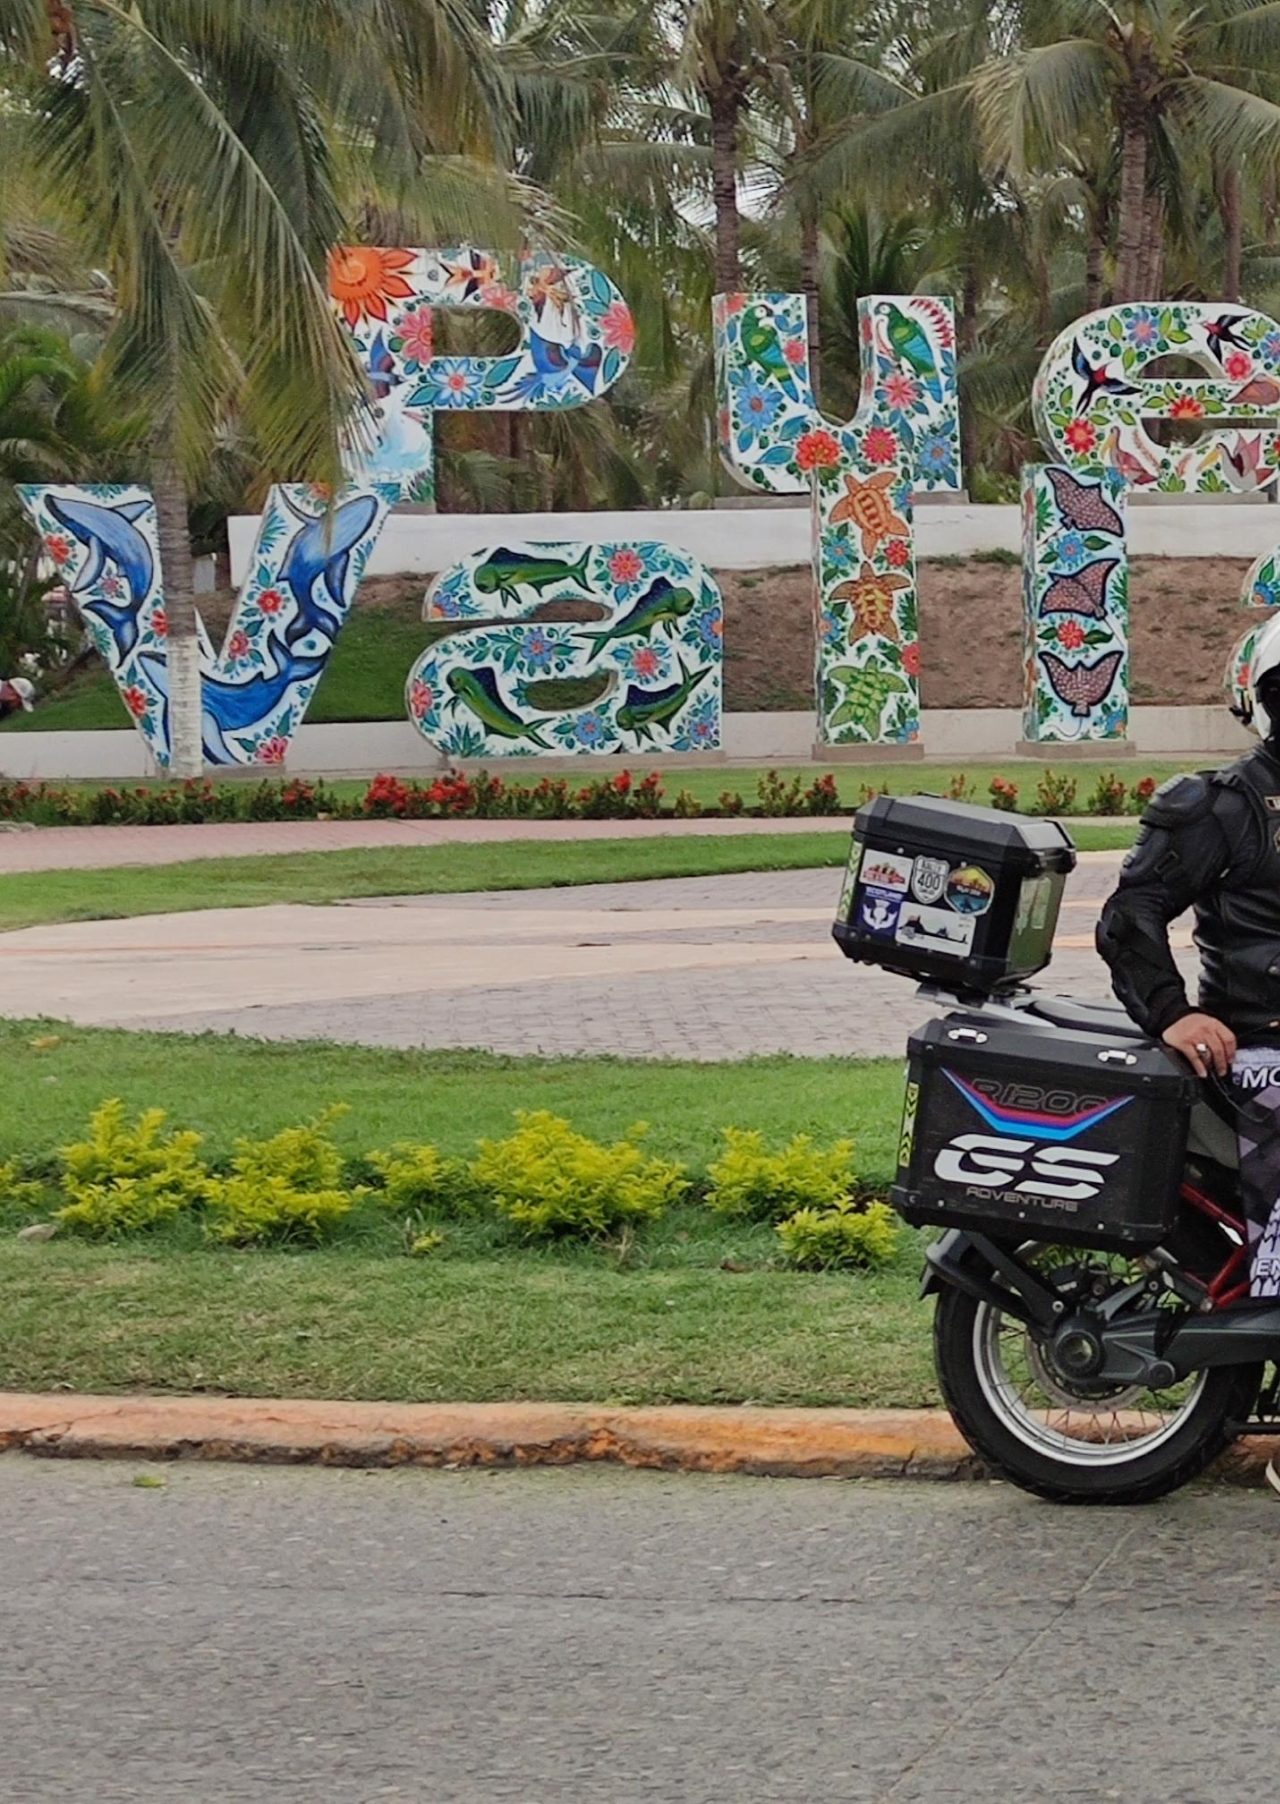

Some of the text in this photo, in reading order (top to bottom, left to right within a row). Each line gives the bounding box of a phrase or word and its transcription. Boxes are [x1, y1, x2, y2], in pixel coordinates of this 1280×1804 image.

[917, 874, 941, 890] 400
[934, 1133, 1121, 1200] GS
[966, 1186, 1079, 1212] ADVENTURE
